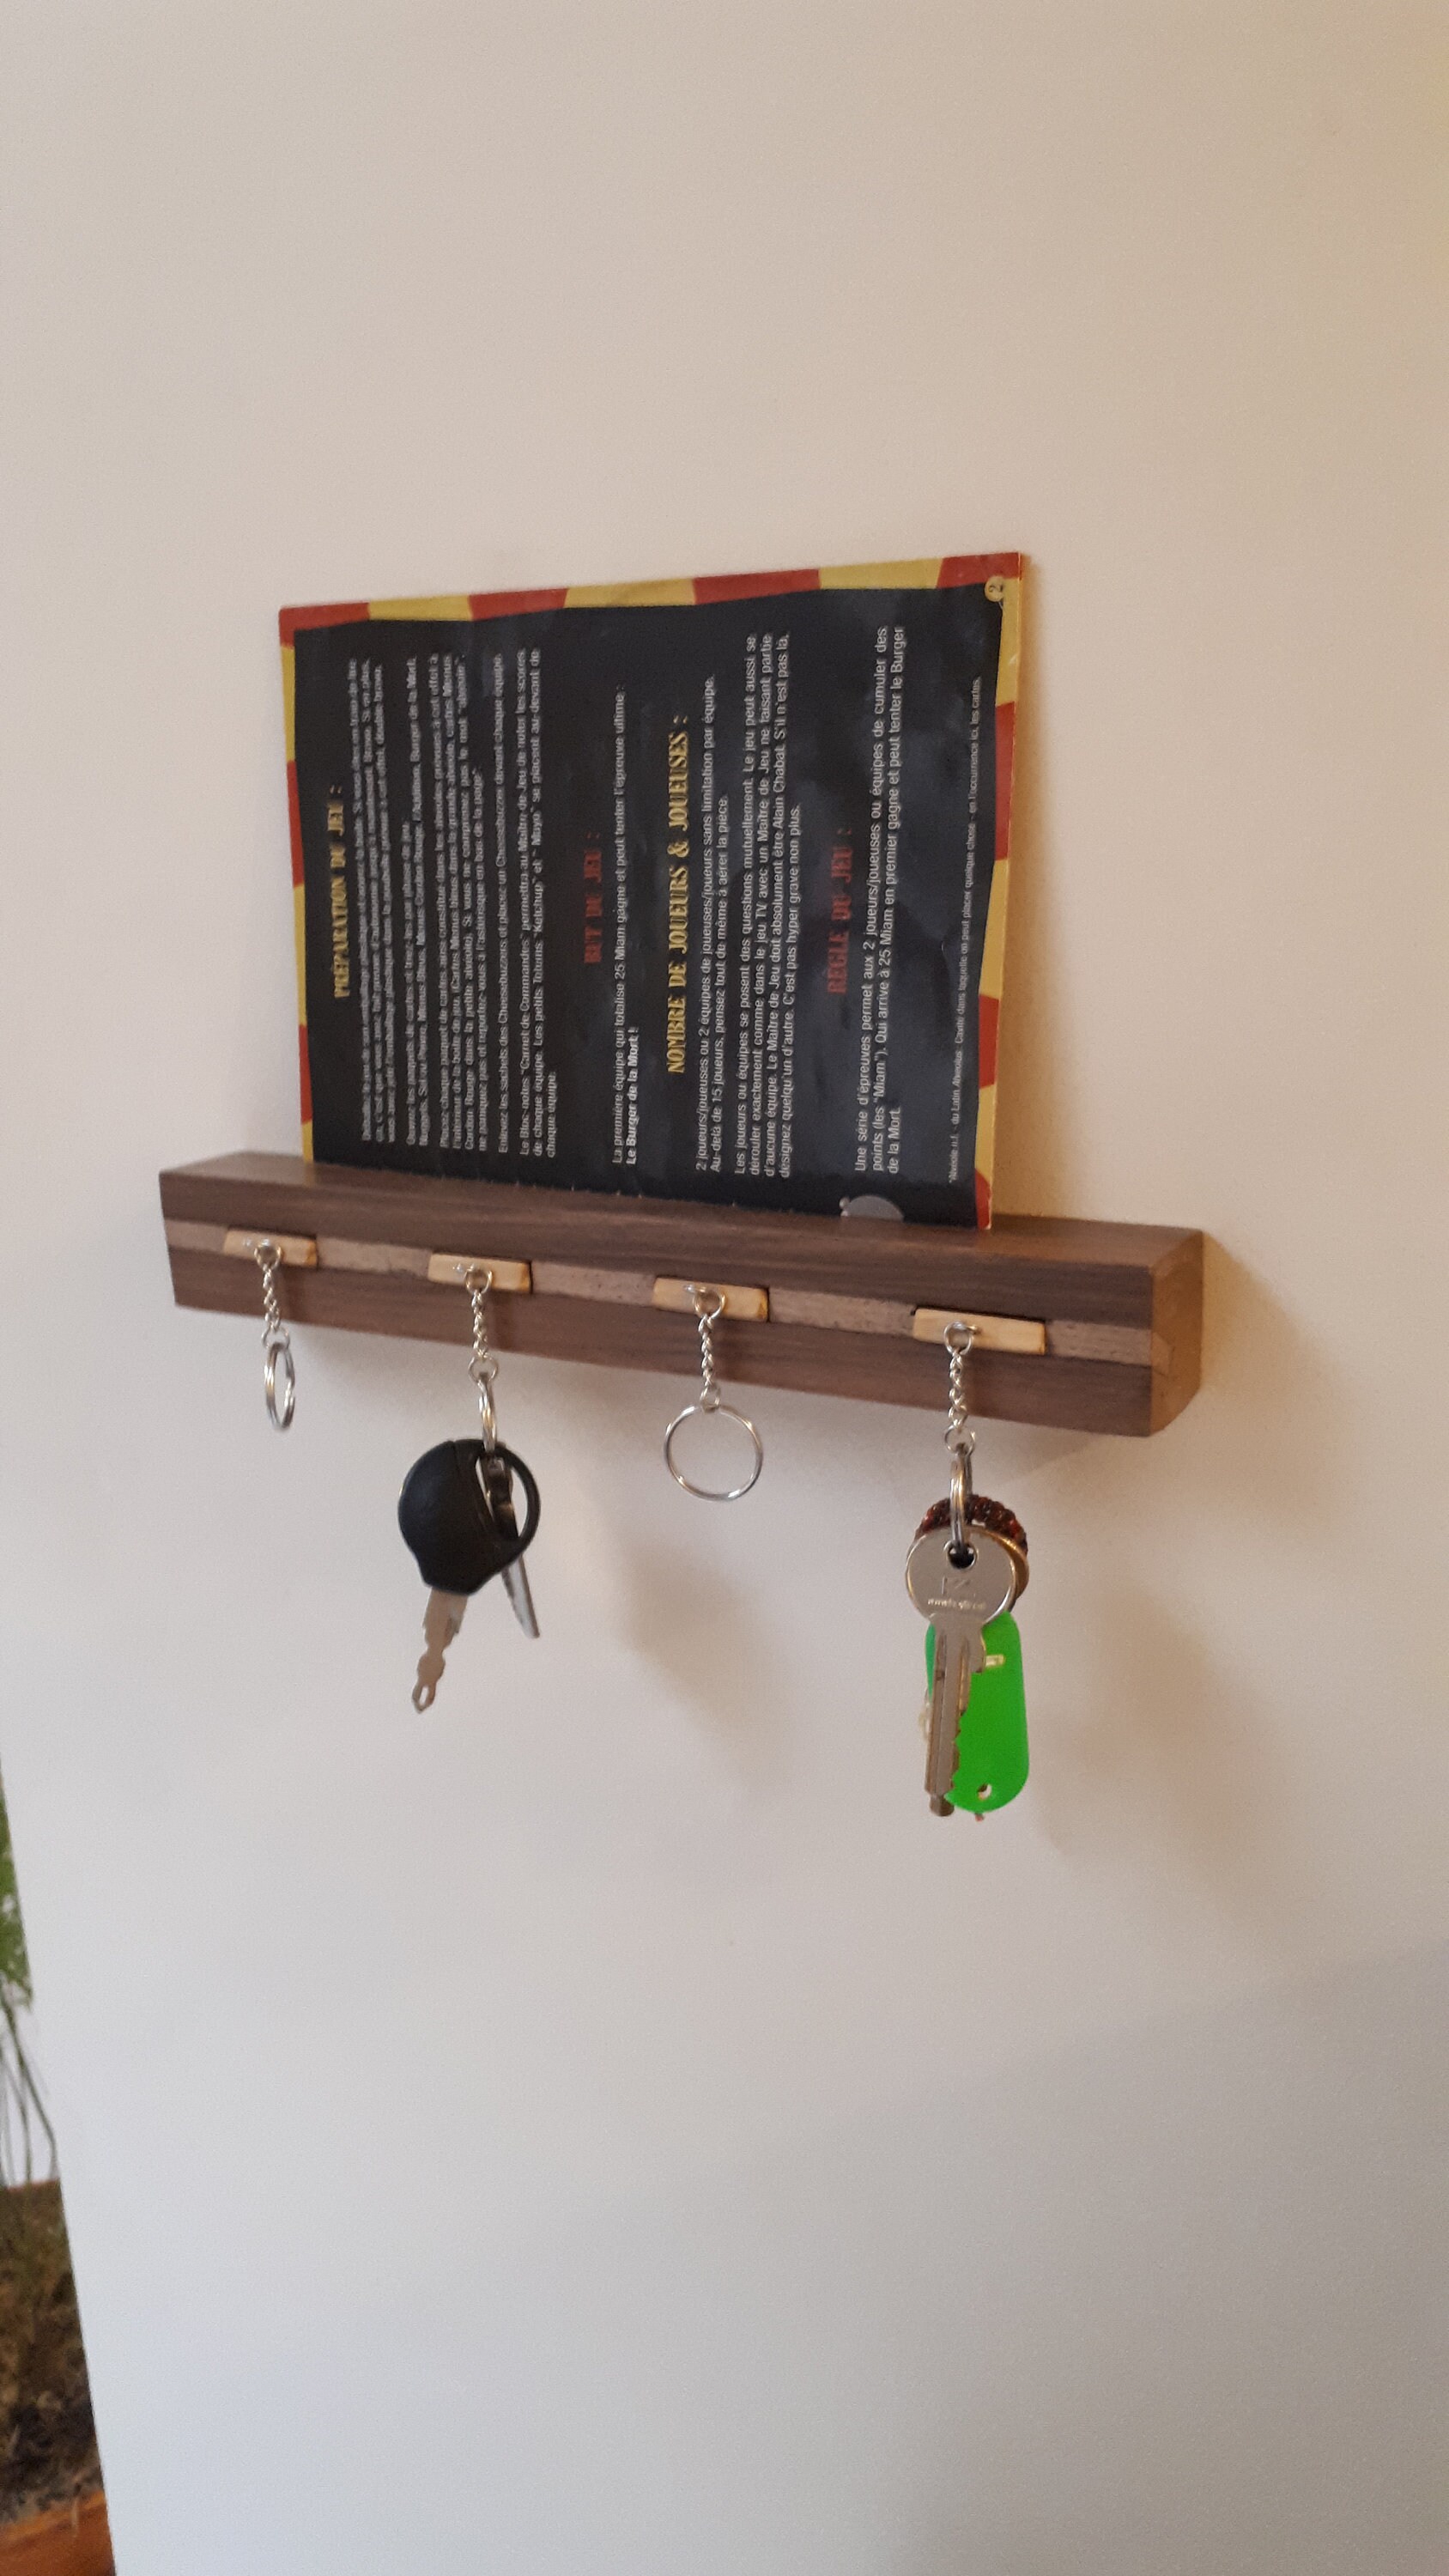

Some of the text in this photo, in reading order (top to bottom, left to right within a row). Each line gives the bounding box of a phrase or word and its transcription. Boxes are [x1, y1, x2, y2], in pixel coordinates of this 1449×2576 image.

[988, 585, 1003, 593] 2
[746, 635, 756, 652] se
[760, 634, 774, 673] partie
[874, 626, 888, 653] des
[888, 626, 906, 673] Burger
[743, 655, 755, 692] aussi
[777, 653, 789, 677] pas
[871, 658, 887, 714] cumuler
[888, 676, 903, 690] le
[743, 695, 757, 726] peut
[887, 693, 901, 732] tenter
[704, 727, 714, 749] par
[743, 730, 756, 750] jeu
[761, 727, 770, 744] ne
[773, 716, 786, 739] S'il
[870, 719, 884, 738] de
[743, 755, 755, 772] Le
[758, 749, 769, 772] Jeu
[886, 736, 903, 767] peut
[668, 732, 688, 830] JOUEUSES
[700, 751, 712, 811] limitation
[869, 742, 885, 796] équipes
[885, 769, 900, 784] et
[757, 778, 769, 795] de
[613, 799, 624, 835] tenter
[756, 799, 769, 841] Maître
[772, 796, 784, 829] Alain
[787, 804, 802, 835] plus.
[870, 800, 882, 818] ou
[887, 787, 902, 829] gagne
[702, 814, 712, 844] sans
[716, 835, 727, 848] la
[613, 837, 627, 866] peut
[667, 841, 688, 857] &
[759, 846, 768, 863] un
[789, 838, 799, 864] non
[882, 833, 899, 884] premier
[614, 868, 625, 881] et
[758, 868, 768, 897] avec
[788, 866, 801, 903] grave
[864, 823, 882, 935] joueurs/joueuses
[616, 884, 627, 923] gagne
[668, 866, 688, 953] JOUEURS
[700, 848, 714, 954] joueuses/joueurs
[740, 872, 754, 934] questions
[755, 902, 767, 918] TV
[770, 860, 784, 935] absolument
[884, 888, 895, 905] en
[714, 899, 727, 939] même
[755, 921, 768, 943] jeu
[785, 907, 799, 943] hyper
[879, 908, 894, 945] Miam
[614, 925, 625, 960] Miam
[714, 942, 726, 958] de
[739, 938, 750, 962] des
[754, 947, 766, 959] le
[769, 937, 781, 963] doit
[786, 945, 798, 969] pas
[877, 948, 891, 966] 25
[614, 963, 625, 979] 25
[668, 962, 686, 987] DE
[699, 957, 711, 973] de
[714, 960, 725, 986] tout
[753, 963, 765, 994] dans
[768, 964, 780, 988] Jeu
[864, 955, 874, 979] aux
[699, 975, 712, 1024] équipes
[737, 964, 751, 1008] posent
[767, 991, 779, 1008] de
[782, 971, 795, 1005] C'est
[876, 981, 889, 1018] arrive
[614, 982, 625, 1026] totalise
[715, 989, 726, 1033] pensez
[859, 983, 876, 1030] permet
[739, 1011, 749, 1027] se
[754, 998, 764, 1045] comme
[766, 1010, 779, 1051] Maître
[874, 1021, 888, 1043] Qui
[613, 1028, 626, 1048] qui
[666, 996, 685, 1073] NOMBRE
[700, 1038, 709, 1055] ou
[627, 1035, 638, 1066] Mort
[736, 1030, 749, 1079] équipes
[766, 1054, 778, 1070] Le
[613, 1050, 626, 1091] équipe
[627, 1068, 637, 1082] la
[857, 1034, 873, 1105] d'épreuves
[627, 1084, 637, 1101] de
[711, 1087, 722, 1102] 15
[737, 1082, 747, 1099] ou
[749, 1048, 762, 1121] exactement
[779, 1059, 795, 1121] quelqu'un
[696, 1057, 710, 1159] joueurs/joueuses
[711, 1106, 721, 1122] de
[871, 1106, 885, 1129] (les
[625, 1103, 639, 1146] Burger
[734, 1103, 748, 1149] joueurs
[856, 1110, 868, 1141] série
[612, 1146, 622, 1163] La
[626, 1148, 636, 1164] Le
[710, 1124, 721, 1172] Au-delà
[734, 1151, 745, 1174] Les
[749, 1125, 761, 1176] dérouler
[763, 1120, 776, 1176] d'aucune
[854, 1145, 867, 1171] Une
[870, 1132, 886, 1171] points
[887, 1141, 900, 1155] la
[886, 1157, 899, 1174] de
